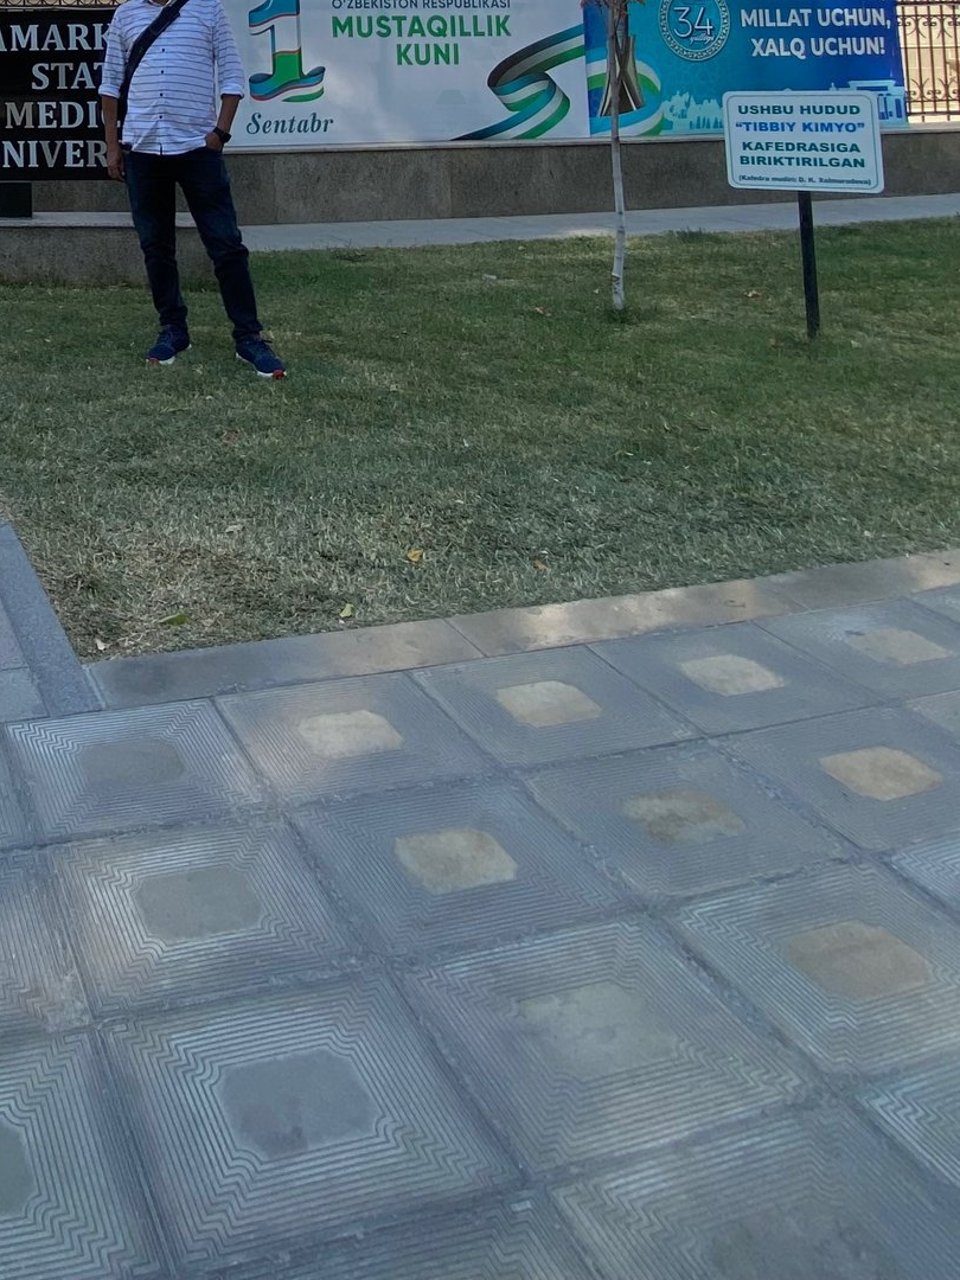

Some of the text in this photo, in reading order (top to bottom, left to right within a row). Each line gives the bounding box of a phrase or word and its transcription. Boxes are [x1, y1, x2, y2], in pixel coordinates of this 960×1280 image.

[331, 15, 512, 38] MUSTAQILLIK
[673, 6, 713, 38] 34
[740, 8, 891, 29] MILLAT UCHUN,
[396, 43, 460, 65] KUNI
[751, 37, 886, 60] XALQ UCHUN!
[31, 62, 105, 90] STA
[5, 101, 105, 129] MEDI
[738, 105, 861, 115] USHBU HUDUD
[246, 111, 334, 135] Sentabr
[742, 141, 861, 153] KAFEDRASIGA
[740, 156, 865, 168] BIRIKTIRILGAN
